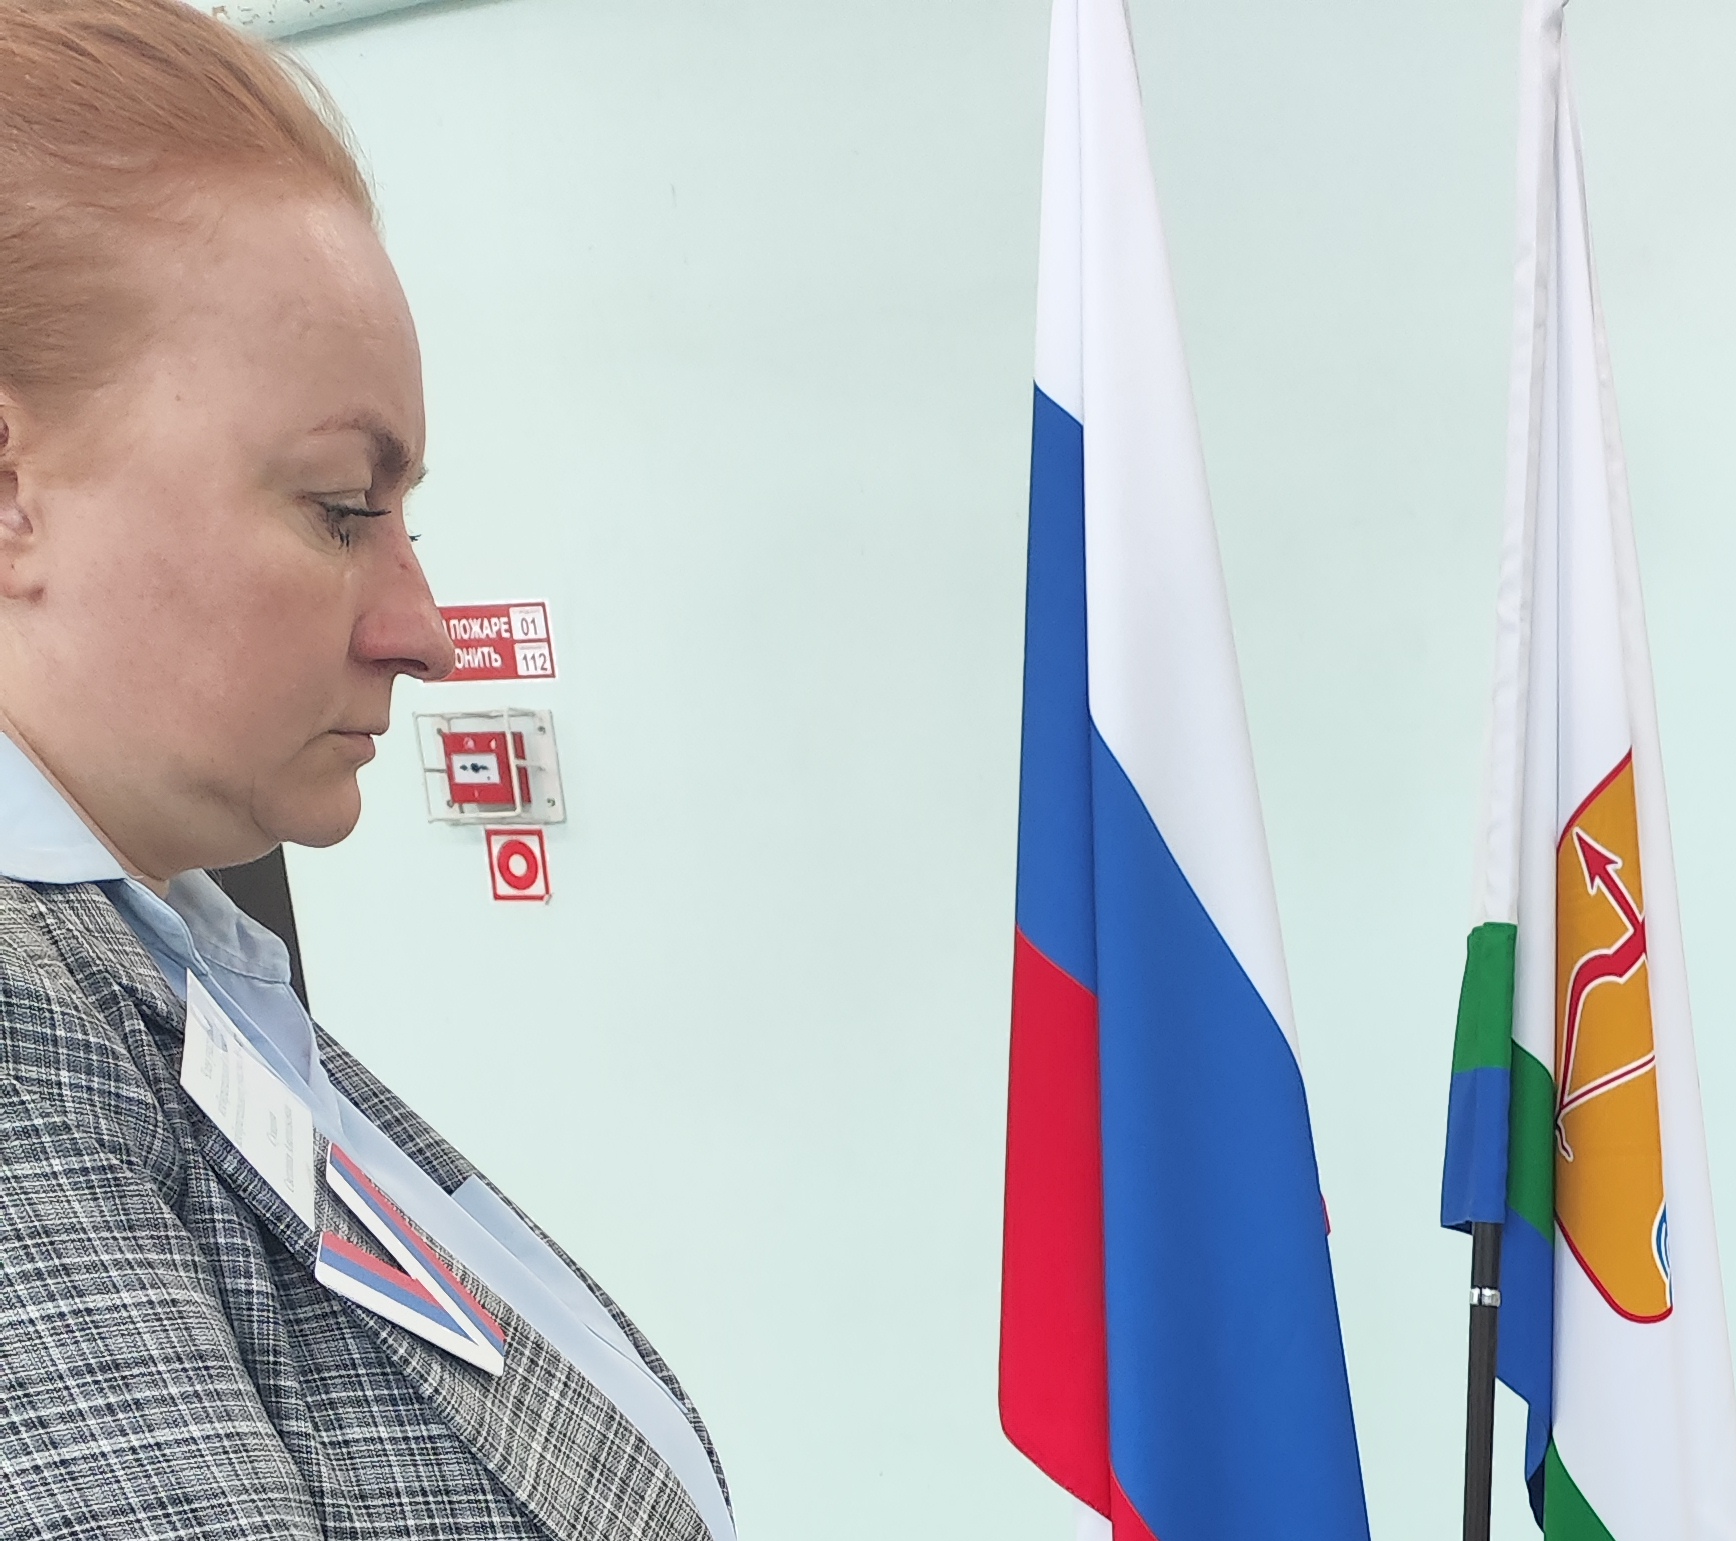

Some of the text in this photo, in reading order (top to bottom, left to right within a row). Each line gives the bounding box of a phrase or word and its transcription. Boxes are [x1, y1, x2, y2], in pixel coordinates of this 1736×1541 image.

[449, 616, 511, 640] ПОЖАРЕ
[520, 617, 538, 636] 01
[454, 646, 503, 669] ОНИТЬ
[522, 653, 548, 672] 112
